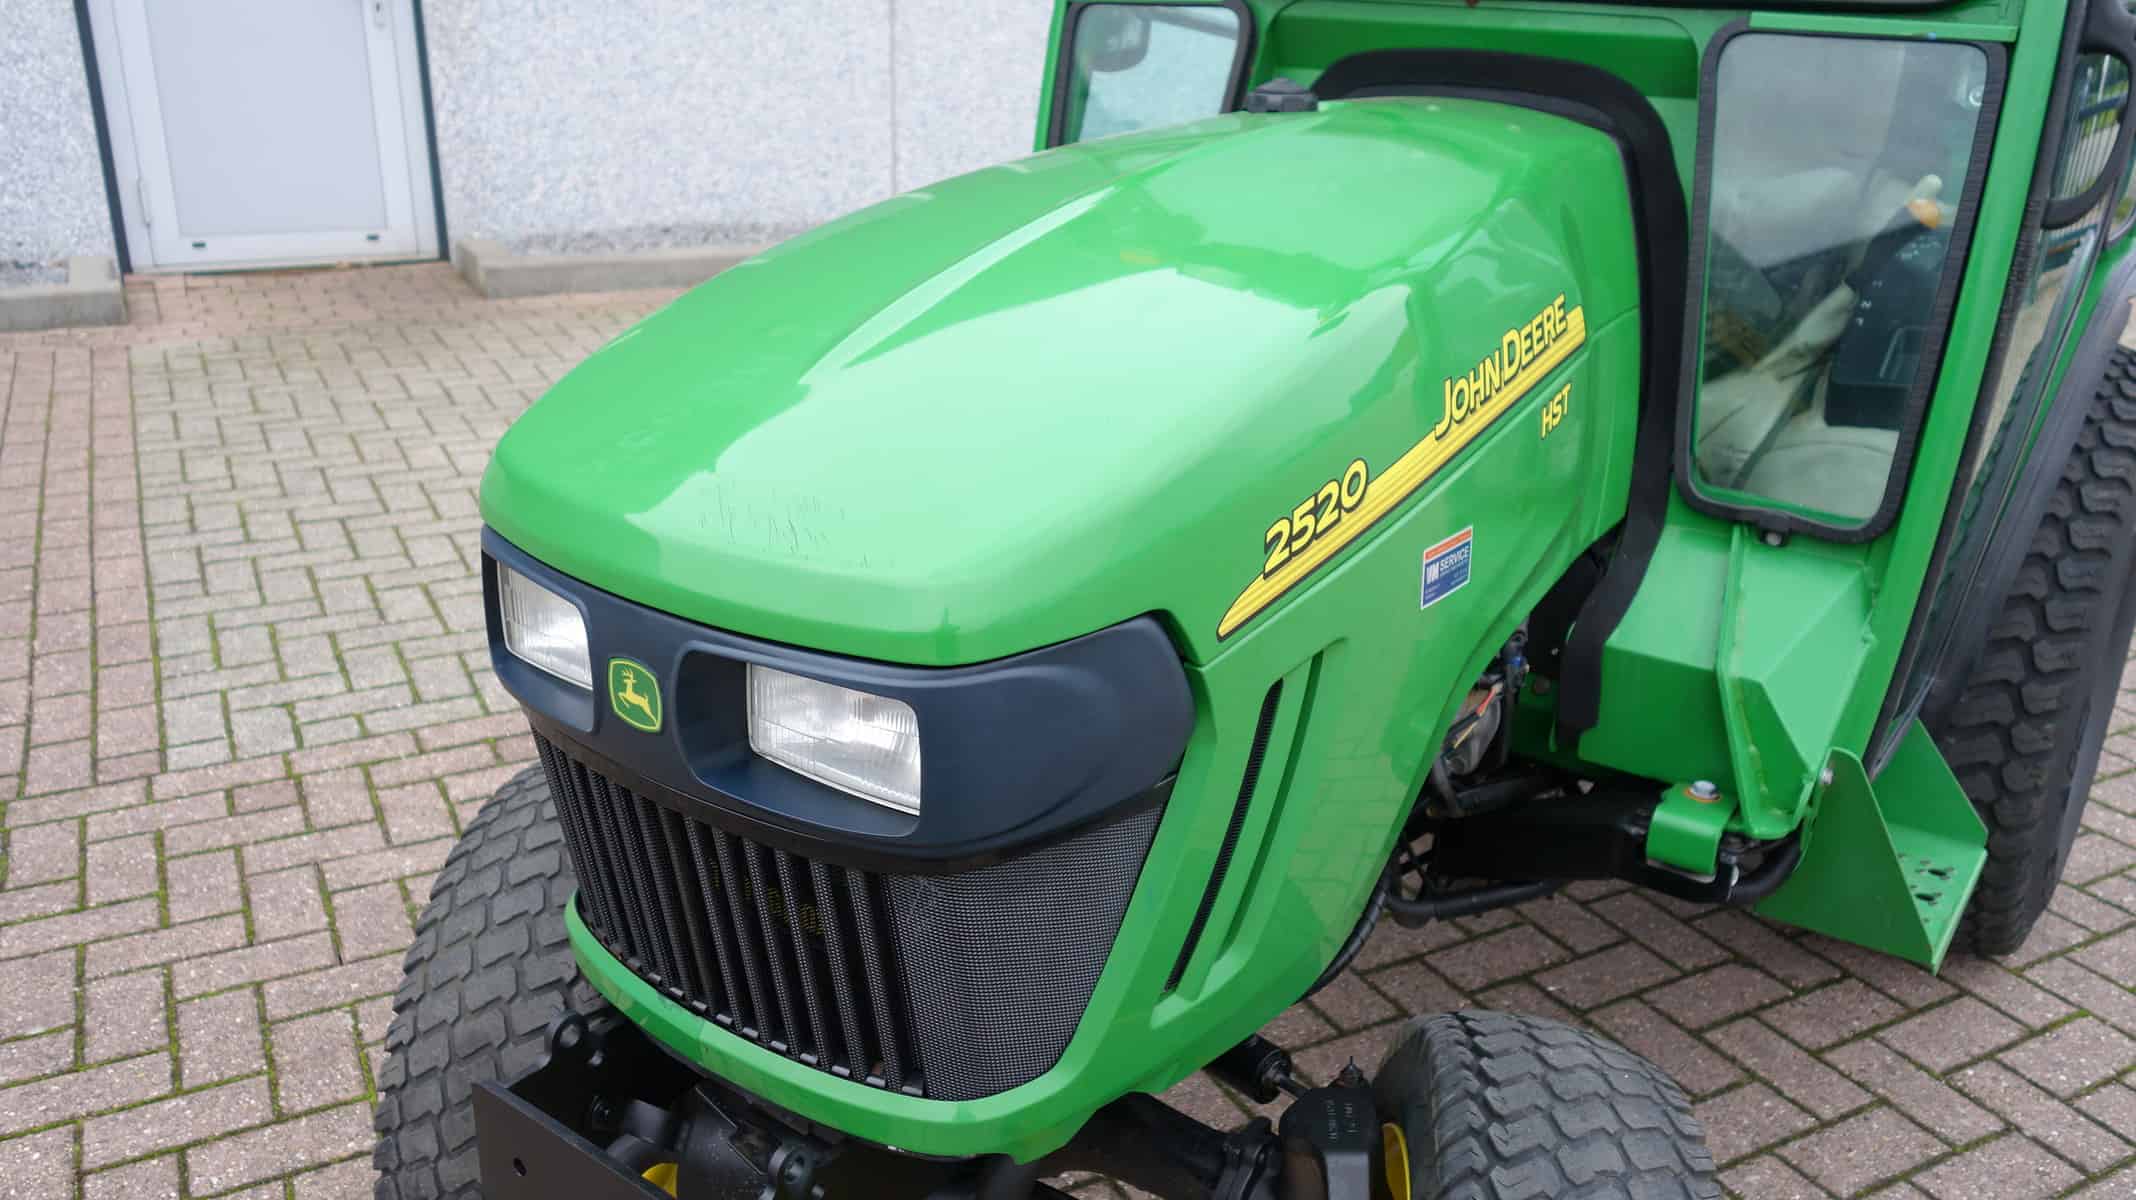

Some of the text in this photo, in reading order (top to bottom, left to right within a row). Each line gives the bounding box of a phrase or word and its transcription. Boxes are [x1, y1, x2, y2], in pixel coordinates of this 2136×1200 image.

[1435, 293, 1568, 440] JOHN DEERE
[1540, 383, 1571, 439] HST
[1264, 458, 1369, 579] 2520
[1440, 545, 1470, 571] SERVICE
